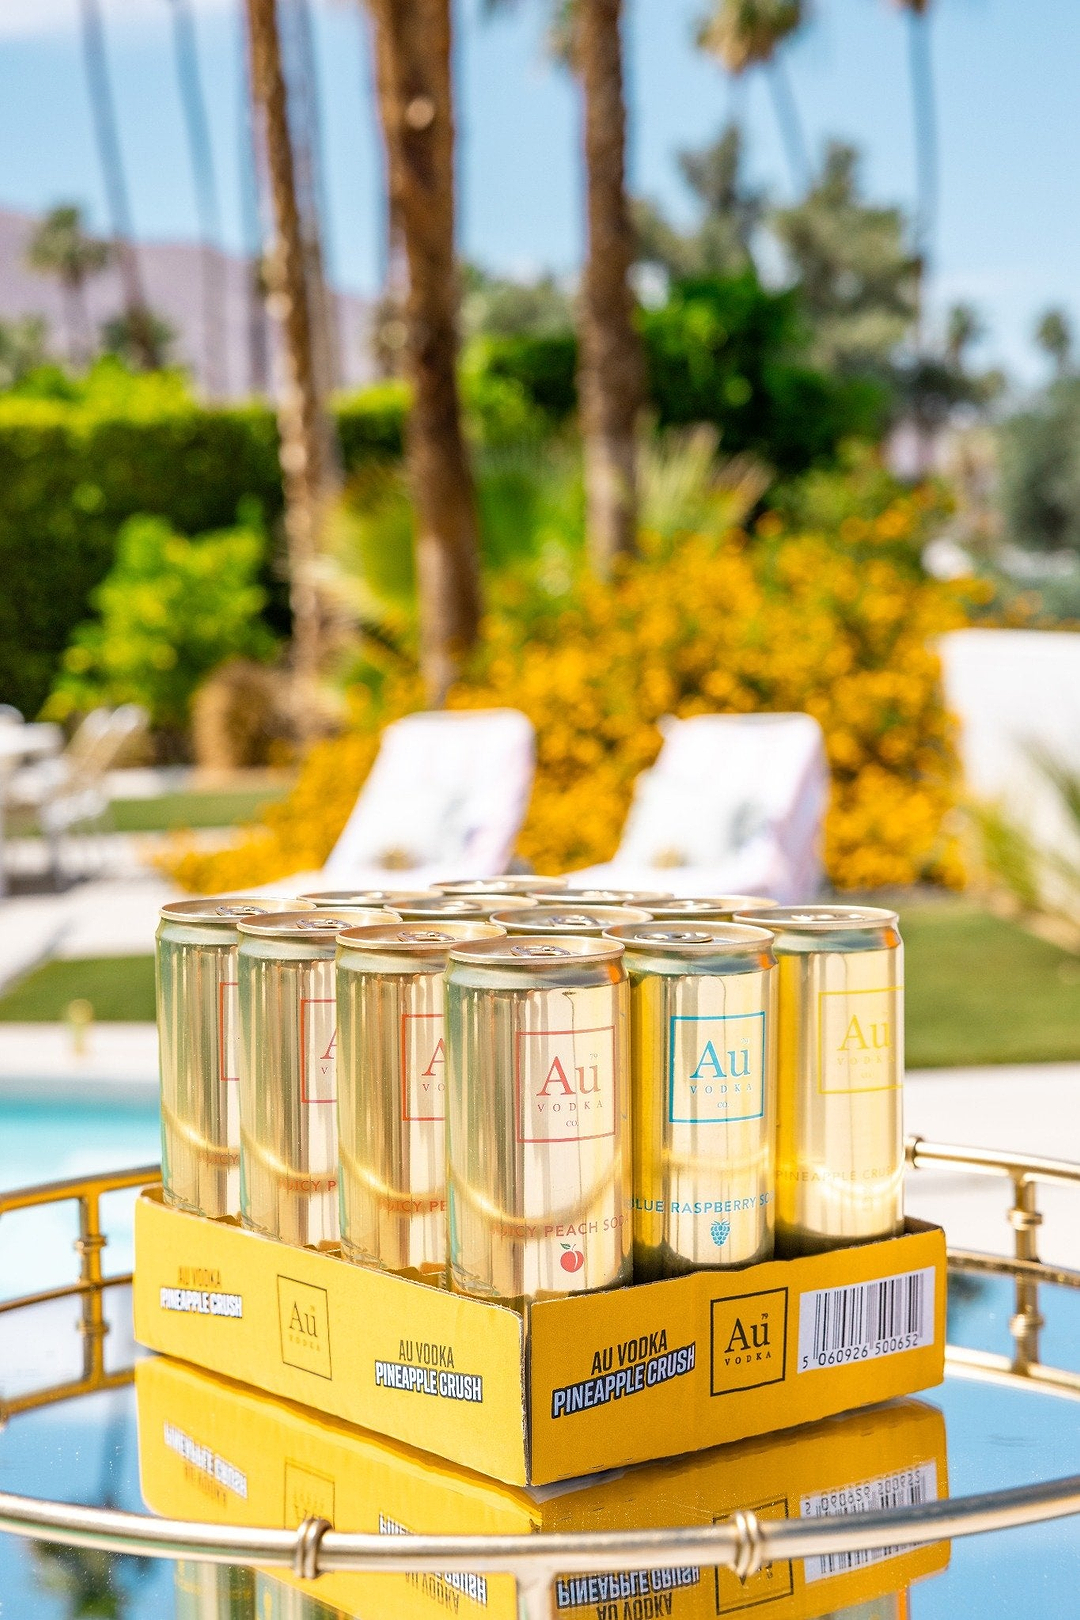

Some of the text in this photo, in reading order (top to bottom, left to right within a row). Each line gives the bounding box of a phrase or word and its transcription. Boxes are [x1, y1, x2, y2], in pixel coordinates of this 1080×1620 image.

[836, 1014, 892, 1051] Au
[536, 1056, 601, 1096] Au
[689, 1040, 751, 1078] Au
[537, 1100, 603, 1113] VODKA
[690, 1083, 752, 1094] VODKA
[671, 1197, 757, 1213] RASPBERRY
[544, 1221, 598, 1237] PEACH
[289, 1301, 318, 1337] Au
[725, 1317, 770, 1353] Au
[399, 1339, 455, 1368] AU VODKA
[591, 1329, 668, 1375] AU VODKA
[725, 1352, 771, 1366] VODKA
[803, 1333, 919, 1369] 5 060926 500652
[375, 1360, 483, 1403] PINEAPPLE CRUSH
[551, 1341, 696, 1419] PINEAPPLE CRUSH
